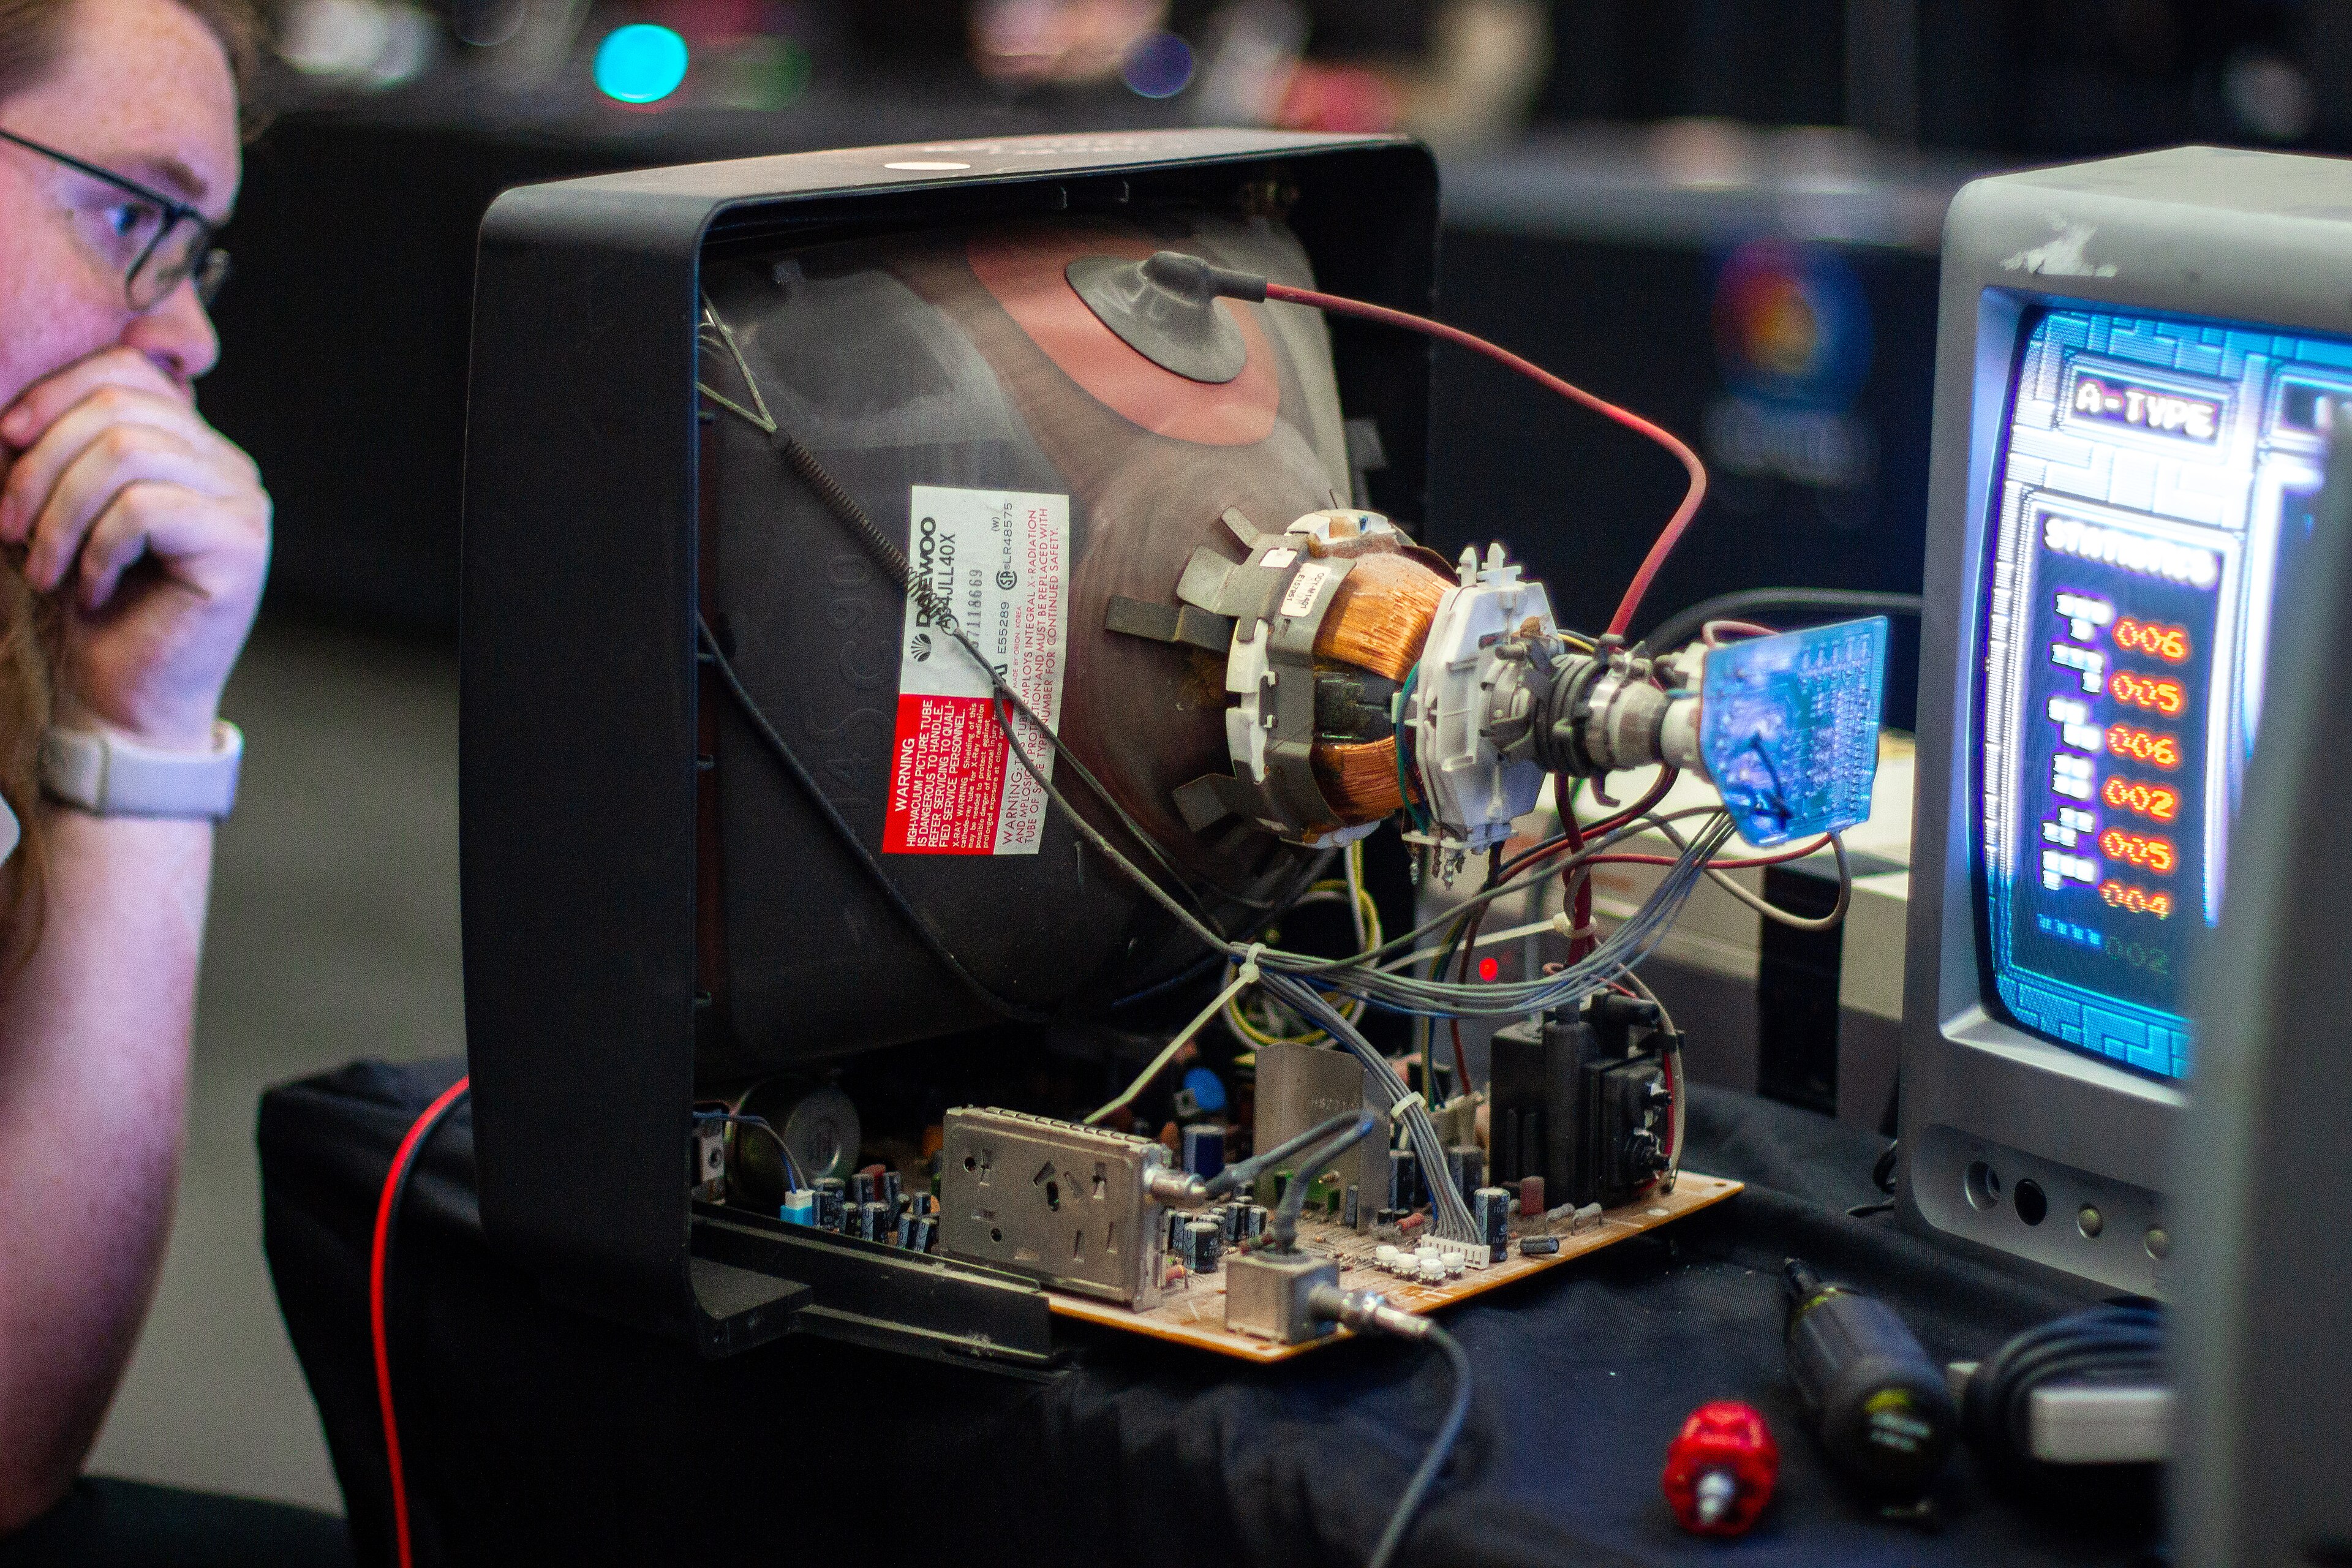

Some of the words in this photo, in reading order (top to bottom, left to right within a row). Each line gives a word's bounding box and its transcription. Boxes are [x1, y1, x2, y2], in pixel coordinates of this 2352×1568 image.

[2076, 382, 2215, 439] A-TYPE
[1039, 508, 1048, 539] WITH
[1028, 510, 1036, 588] X-RADIATION
[1049, 527, 1058, 571] SAFETY.
[1038, 542, 1048, 600] REPLACED
[997, 601, 1009, 654] E55289
[1024, 592, 1036, 649] INTEGRAL
[1038, 603, 1047, 617] BE
[1047, 576, 1058, 646] CONTINUED
[1036, 620, 1046, 652] MUST
[2116, 620, 2185, 658] 006
[1035, 655, 1044, 679] AND
[1045, 652, 1055, 673] FOR
[2113, 674, 2180, 712] 005
[921, 700, 932, 730] TUBE
[930, 705, 943, 752] HANDLE.
[942, 701, 955, 737] QUALI-
[968, 721, 974, 730] of
[941, 739, 951, 753] TO
[949, 709, 965, 774] PERSONNEL.
[982, 719, 991, 748] against
[987, 724, 998, 747] injury
[2108, 726, 2177, 765] 006
[915, 733, 929, 777] PICTURE
[927, 755, 938, 769] TO
[963, 734, 974, 769] Shielding
[976, 751, 988, 779] protect
[986, 749, 995, 781] personal
[895, 738, 914, 812] WARNING
[933, 756, 949, 810] SERVICING
[960, 805, 972, 848] cathode-ray
[971, 744, 980, 767] X-Ray
[976, 704, 984, 738] radiation
[984, 782, 990, 791] of
[989, 777, 998, 810] exposure
[994, 766, 1000, 774] at
[907, 780, 923, 846] HIGH-VACUUM
[919, 773, 936, 834] DANGEROUS
[944, 777, 957, 821] SERVICE
[957, 777, 968, 816] WARNING
[971, 793, 981, 819] needed
[979, 792, 989, 816] danger
[1002, 767, 1022, 845] WARNING:
[1030, 799, 1039, 813] OF
[2105, 779, 2174, 819] 002
[918, 837, 927, 846] IS
[928, 813, 941, 847] REFER
[939, 824, 951, 847] FIED
[953, 821, 962, 847] X-RAY
[968, 834, 976, 848] may
[970, 821, 976, 831] be
[975, 818, 985, 848] possible
[1015, 821, 1025, 843] AND
[1025, 819, 1036, 843] TUBE
[2103, 831, 2172, 870] 005
[2101, 884, 2169, 921] 004
[2105, 937, 2169, 974] 002
